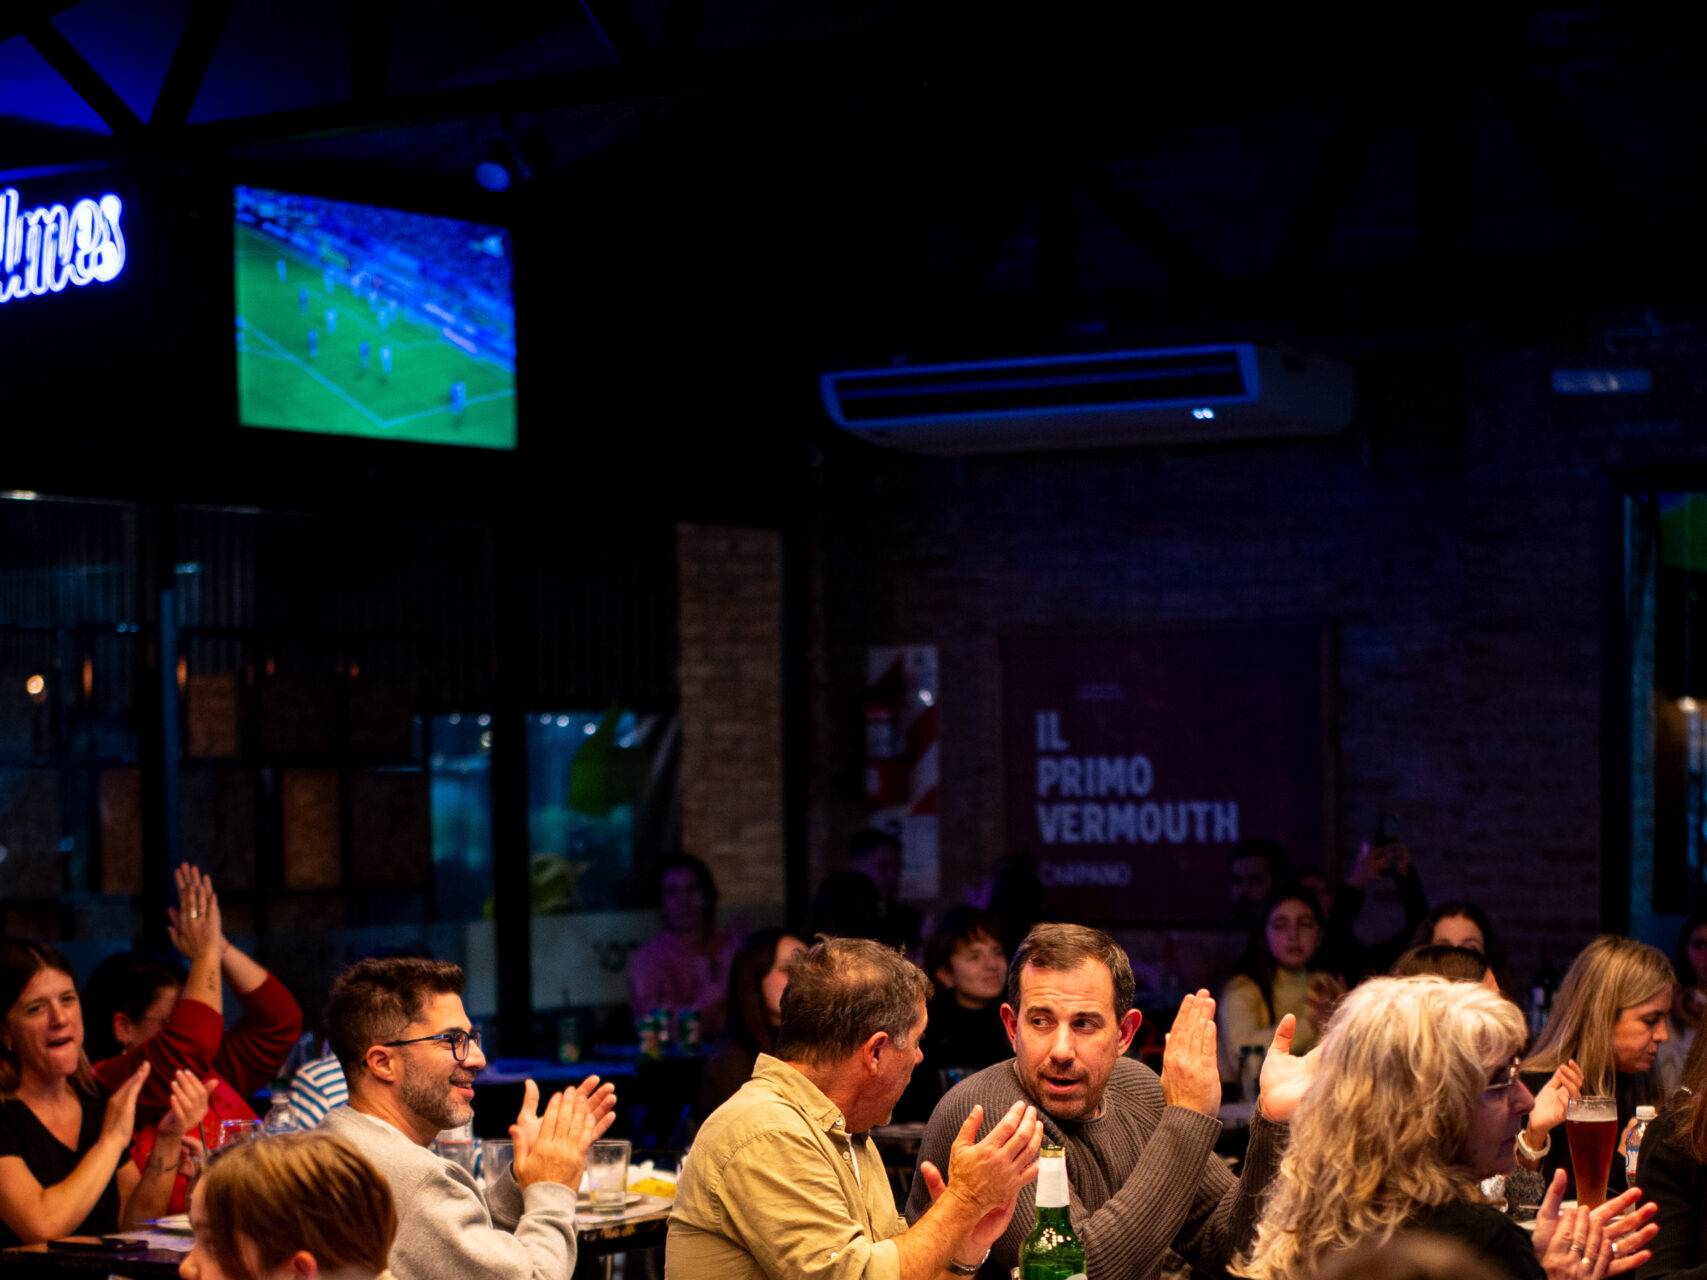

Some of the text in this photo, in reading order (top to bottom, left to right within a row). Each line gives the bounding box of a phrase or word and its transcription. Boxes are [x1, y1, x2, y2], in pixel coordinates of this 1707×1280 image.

[1034, 709, 1070, 752] IL
[1035, 754, 1155, 798] PRIMO
[1034, 800, 1240, 845] VERMOUTH
